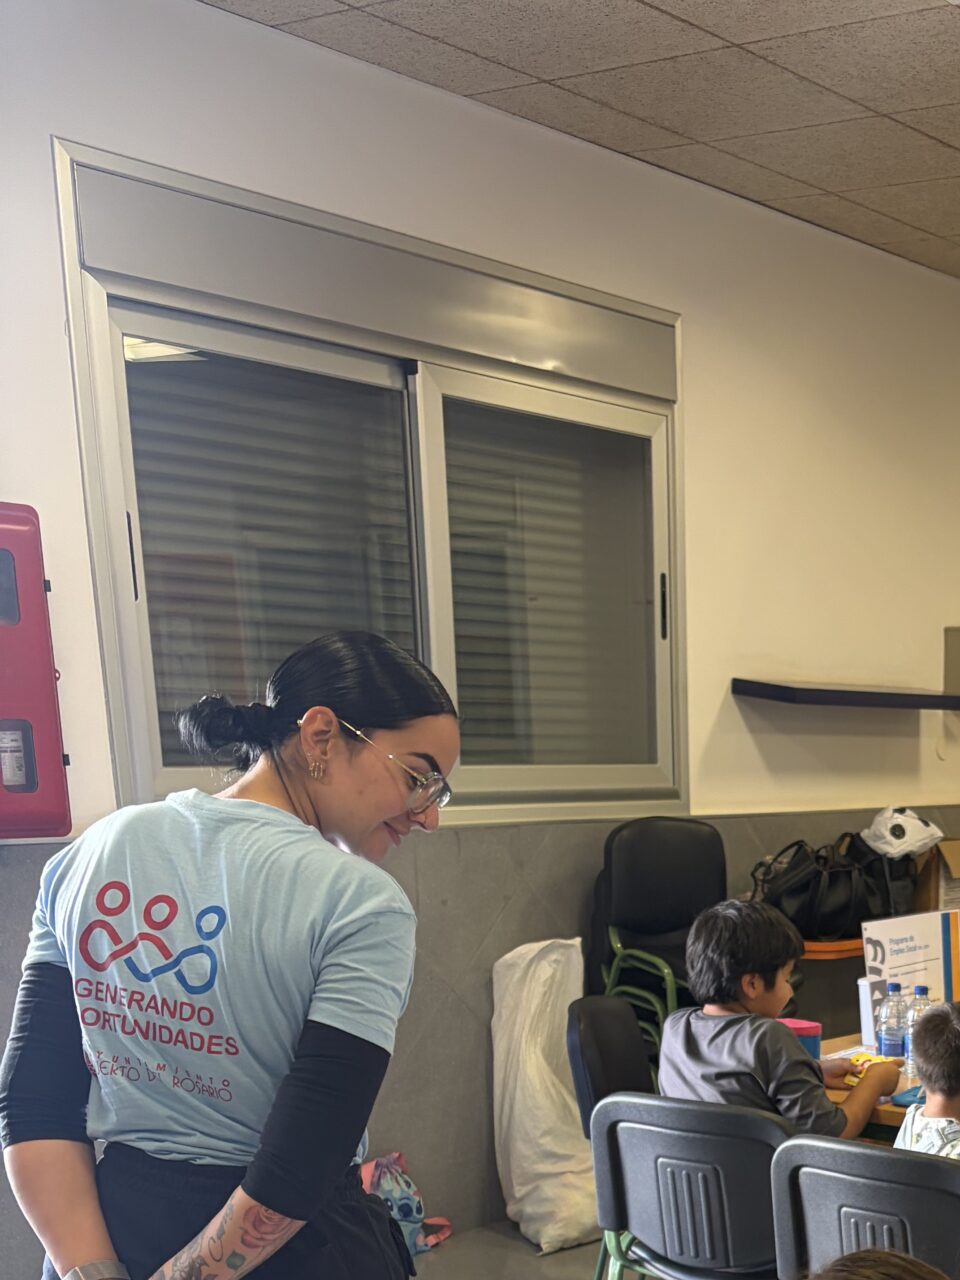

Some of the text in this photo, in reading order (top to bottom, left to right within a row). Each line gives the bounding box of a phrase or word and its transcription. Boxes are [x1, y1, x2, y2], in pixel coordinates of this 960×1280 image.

[75, 977, 214, 1027] GENERANDO
[79, 1006, 240, 1057] ORTUNIDADES
[172, 1075, 233, 1102] ROSARIO
